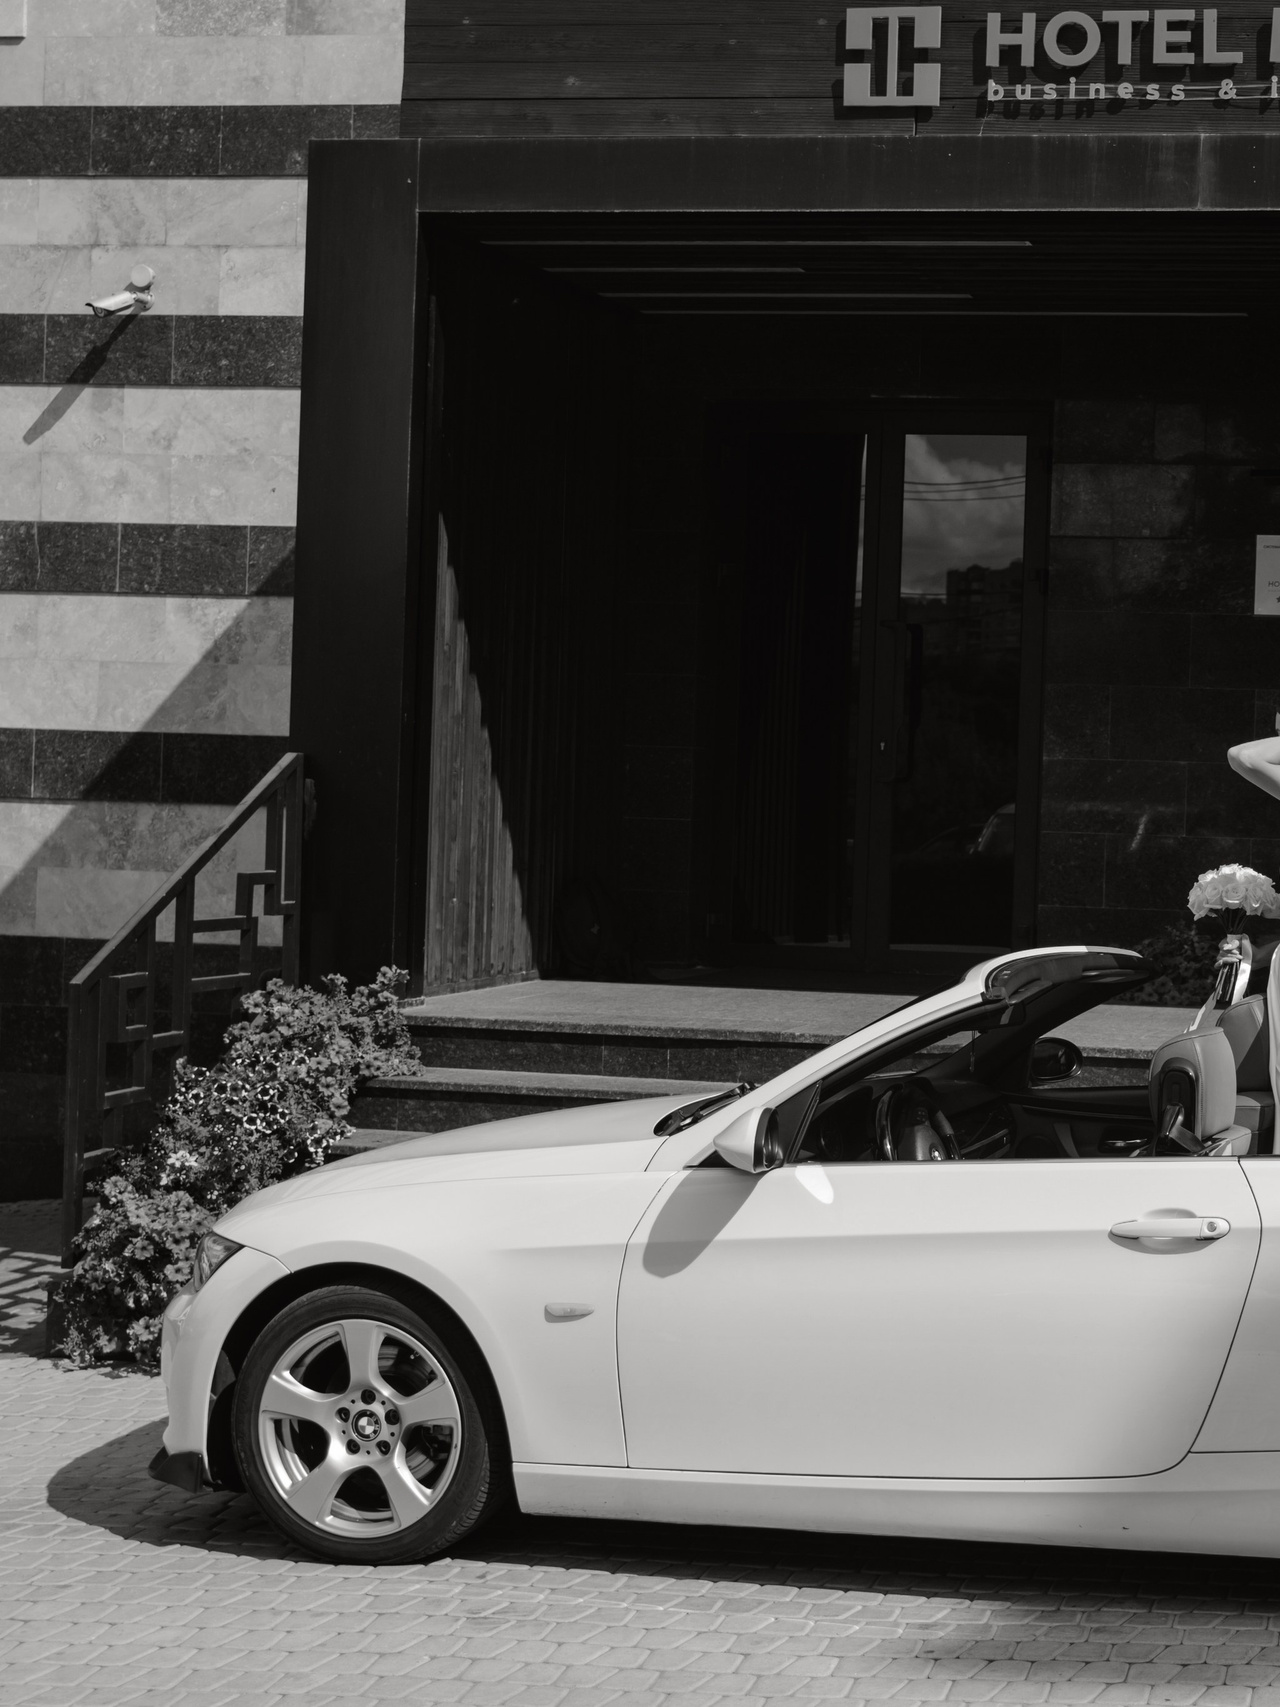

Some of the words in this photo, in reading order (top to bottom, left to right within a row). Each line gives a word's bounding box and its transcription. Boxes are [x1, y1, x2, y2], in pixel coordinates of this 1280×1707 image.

[986, 9, 1243, 67] HOTEL
[987, 77, 1185, 101] business
[1218, 79, 1237, 99] &
